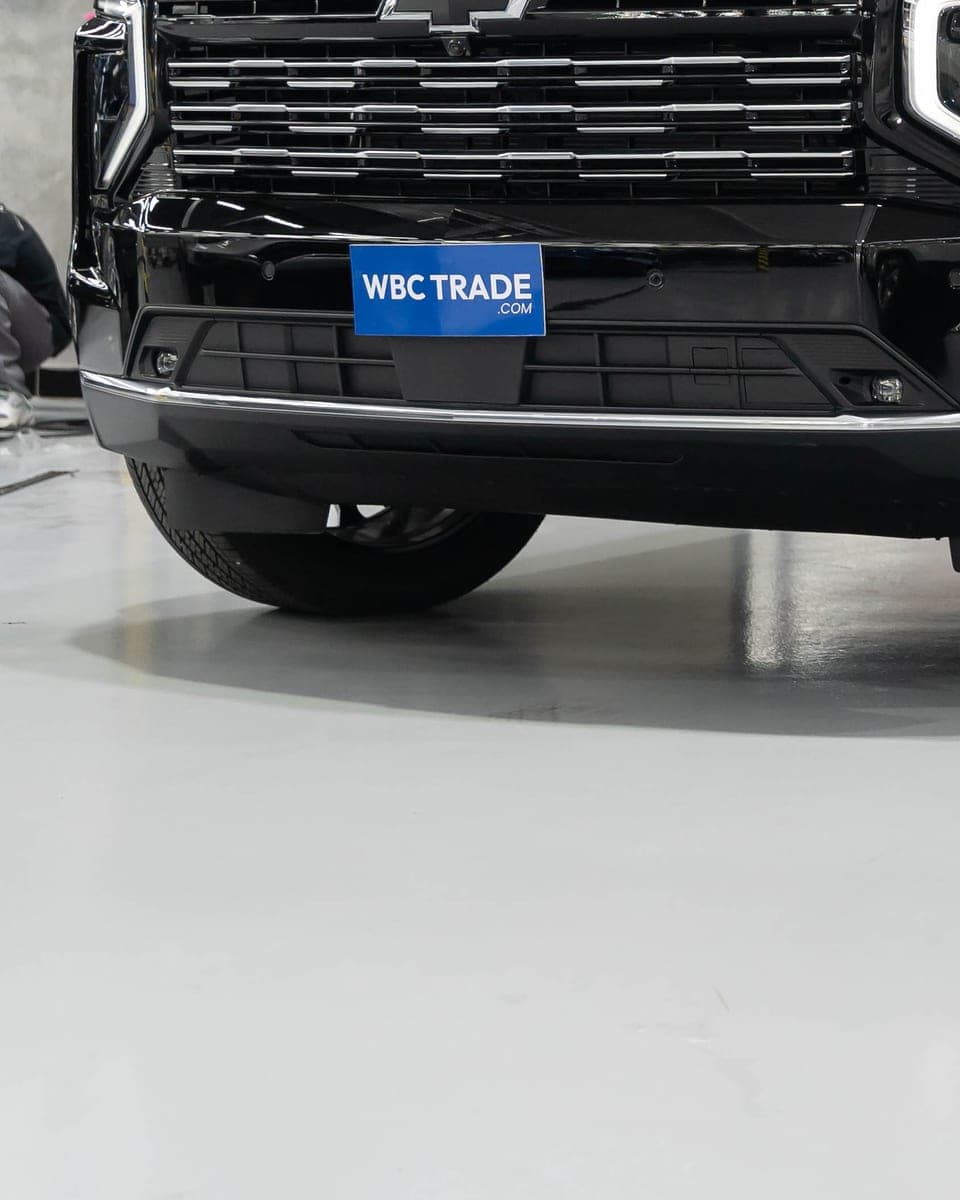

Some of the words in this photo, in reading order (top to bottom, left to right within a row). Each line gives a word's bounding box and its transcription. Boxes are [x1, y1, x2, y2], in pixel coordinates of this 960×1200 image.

[362, 273, 426, 301] WBC
[429, 273, 532, 301] TRADE
[497, 302, 532, 315] .COM
